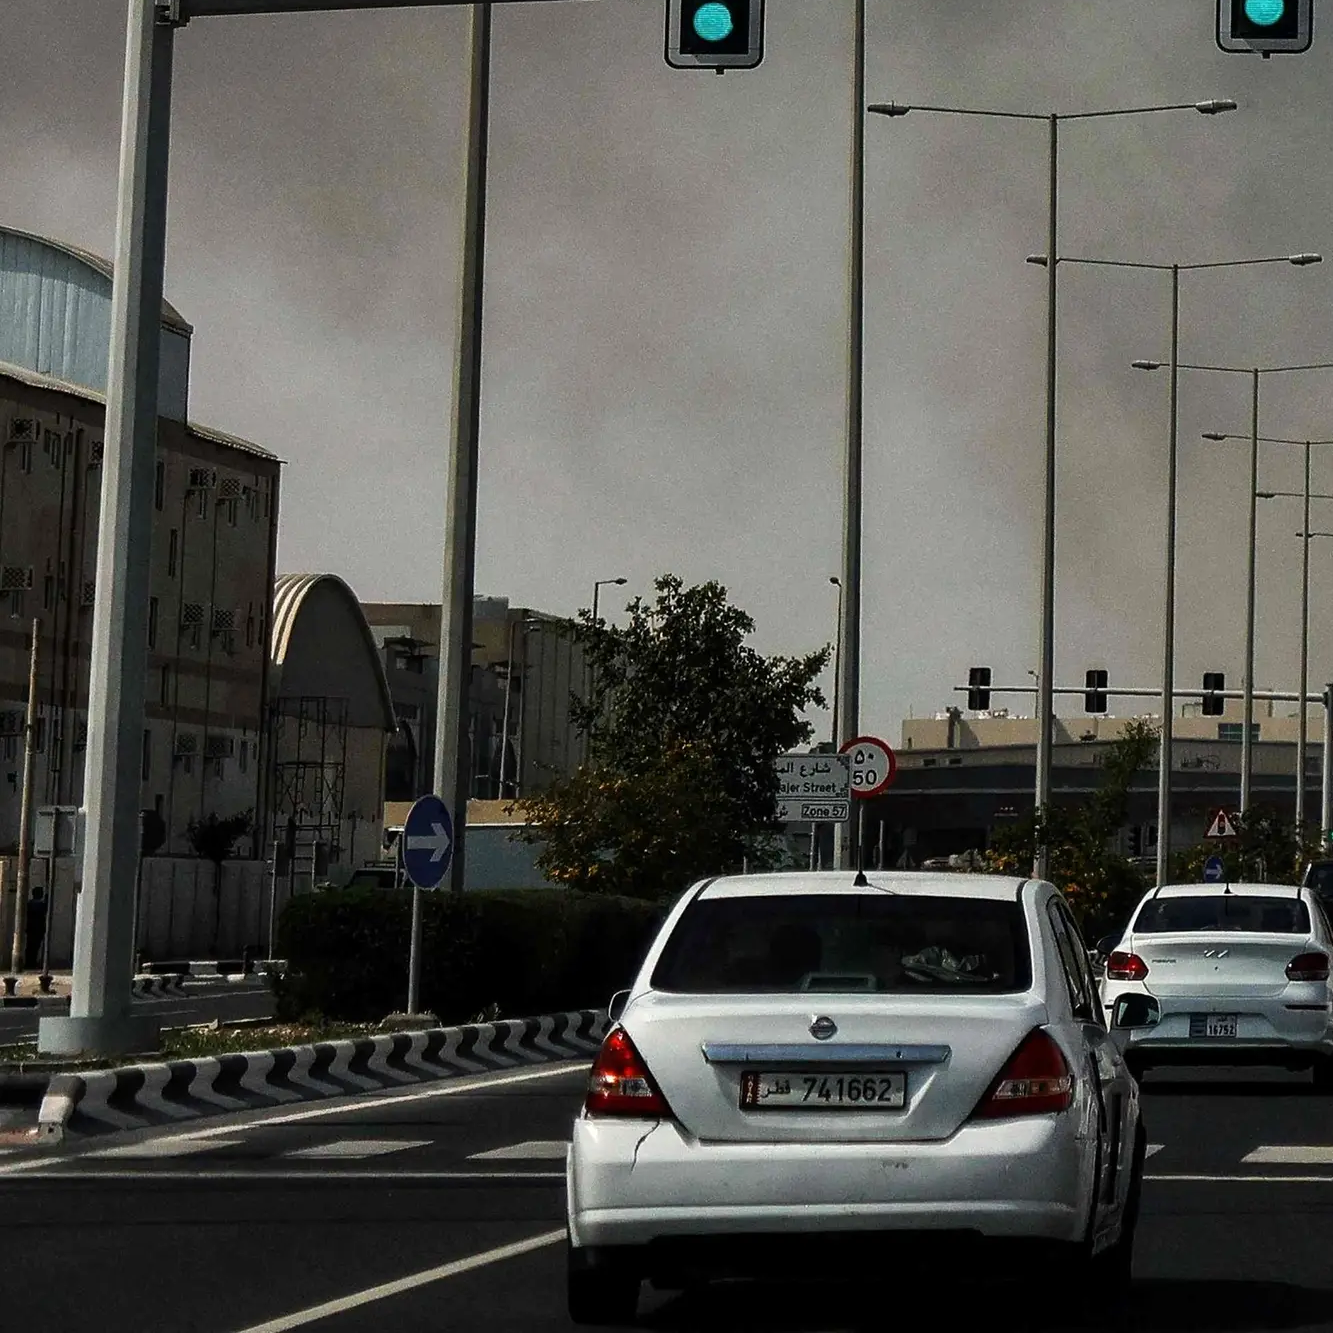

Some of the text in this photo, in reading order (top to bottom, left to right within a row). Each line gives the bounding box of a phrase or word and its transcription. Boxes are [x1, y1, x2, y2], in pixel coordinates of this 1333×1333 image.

[853, 770, 877, 785] 50
[777, 782, 836, 795] ajer Street
[804, 806, 845, 816] Zone 57
[761, 1078, 790, 1098] قطر
[802, 1077, 892, 1102] 741662
